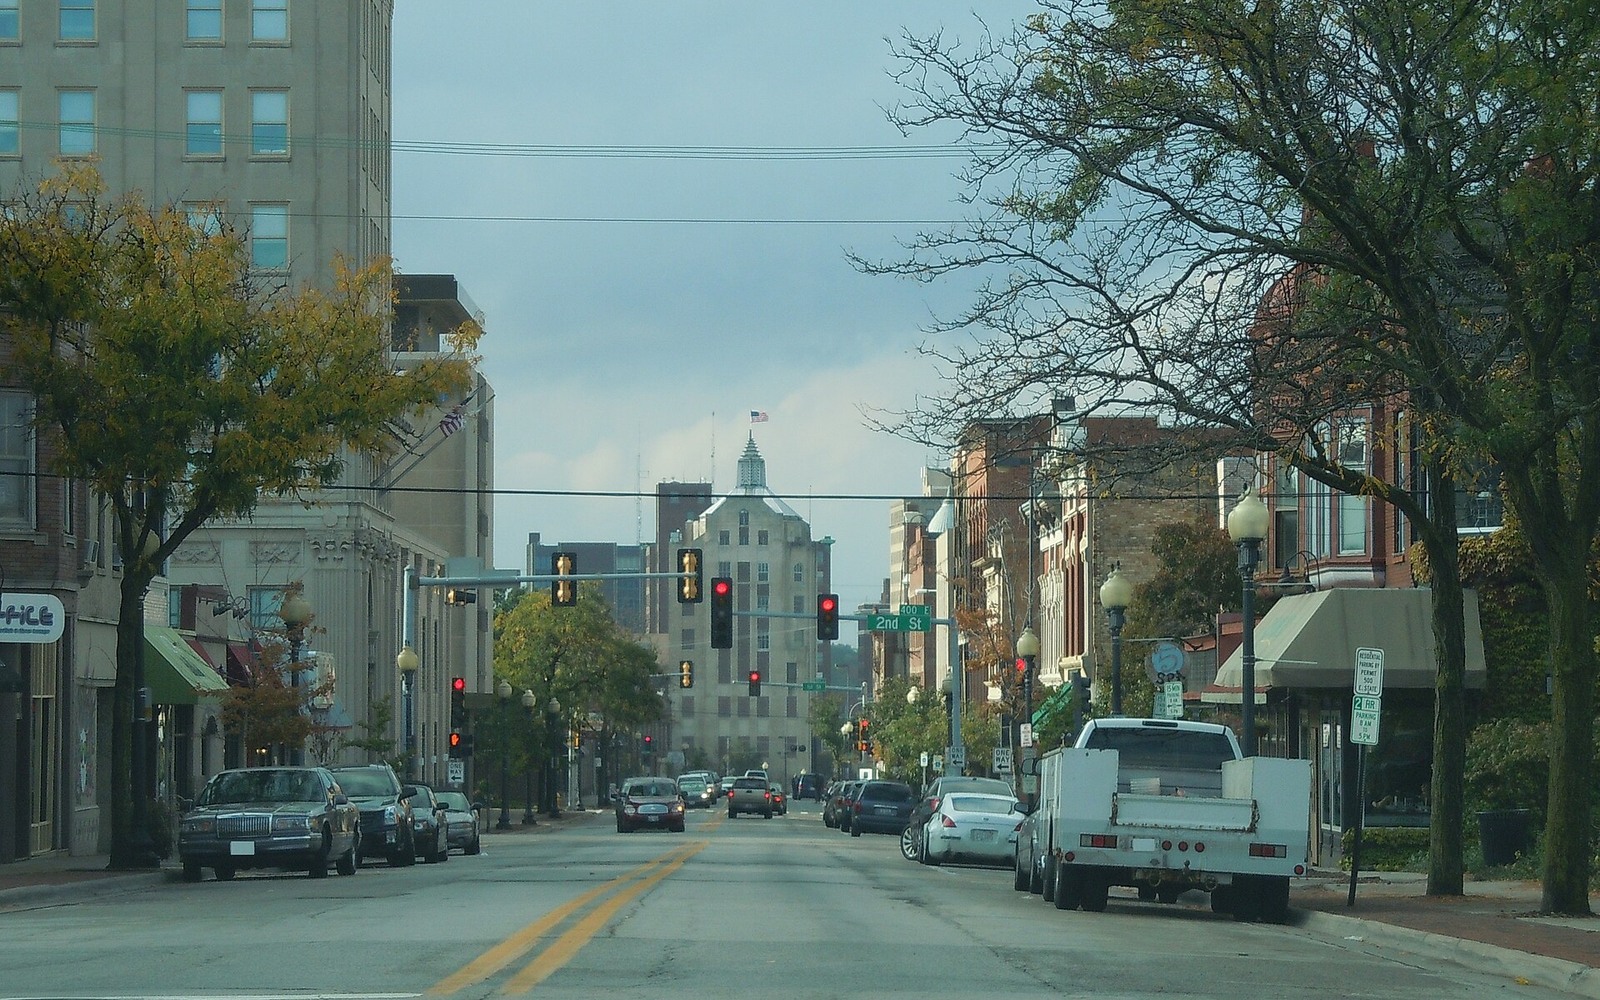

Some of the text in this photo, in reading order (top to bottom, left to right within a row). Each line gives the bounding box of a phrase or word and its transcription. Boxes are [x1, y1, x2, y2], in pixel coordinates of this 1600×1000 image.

[900, 605, 930, 614] 400 E
[876, 616, 922, 630] 2nd St
[1355, 697, 1361, 709] 2
[1355, 711, 1376, 720] PARKING
